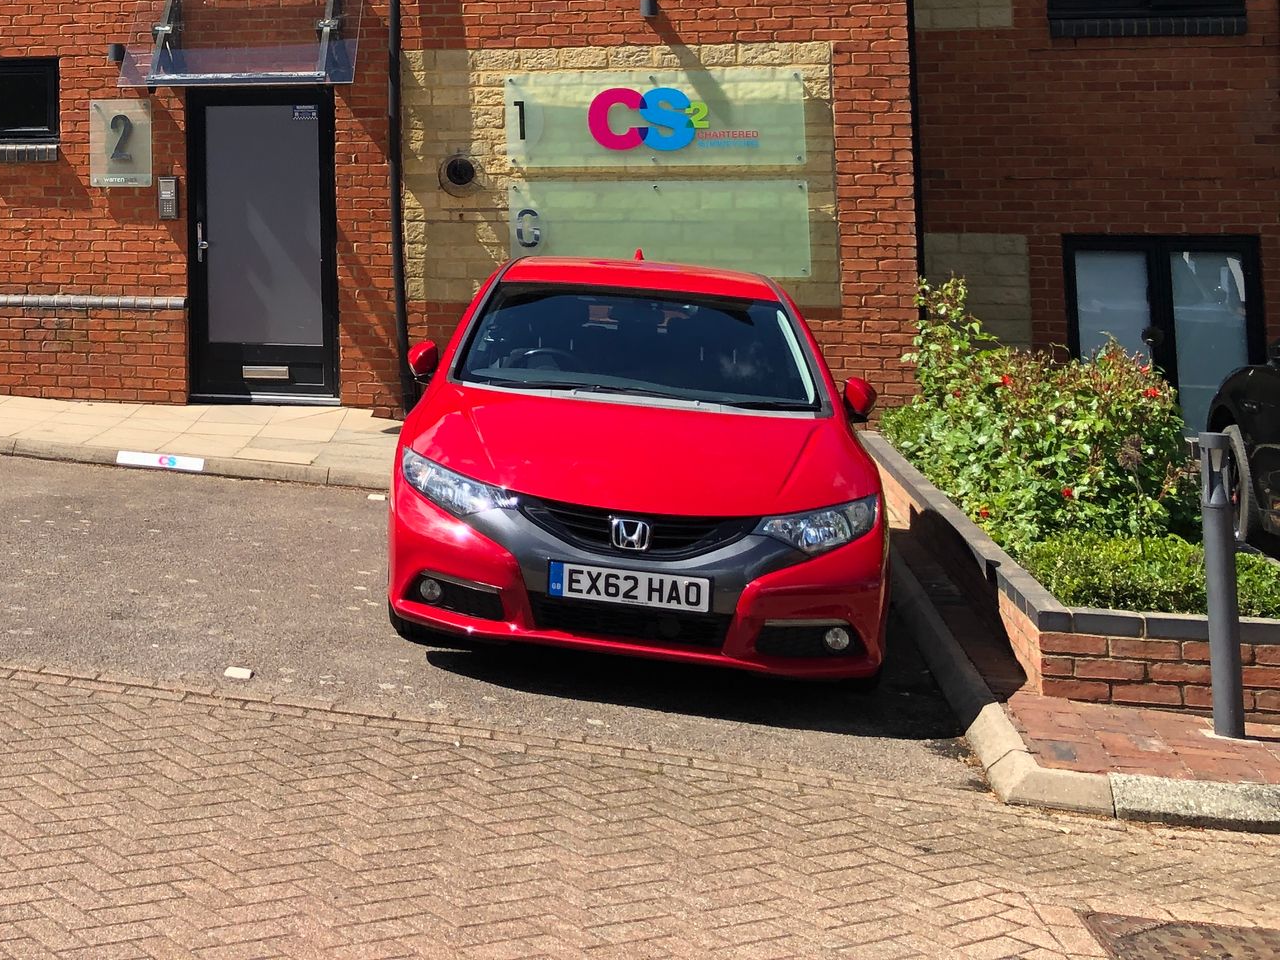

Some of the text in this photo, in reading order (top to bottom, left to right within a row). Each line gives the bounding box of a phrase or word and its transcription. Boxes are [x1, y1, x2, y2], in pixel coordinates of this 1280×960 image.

[110, 114, 133, 161] 2
[514, 101, 526, 140] 1
[697, 129, 759, 139] CHARTERED
[551, 582, 561, 590] GB
[568, 568, 701, 607] EX62 HAO
